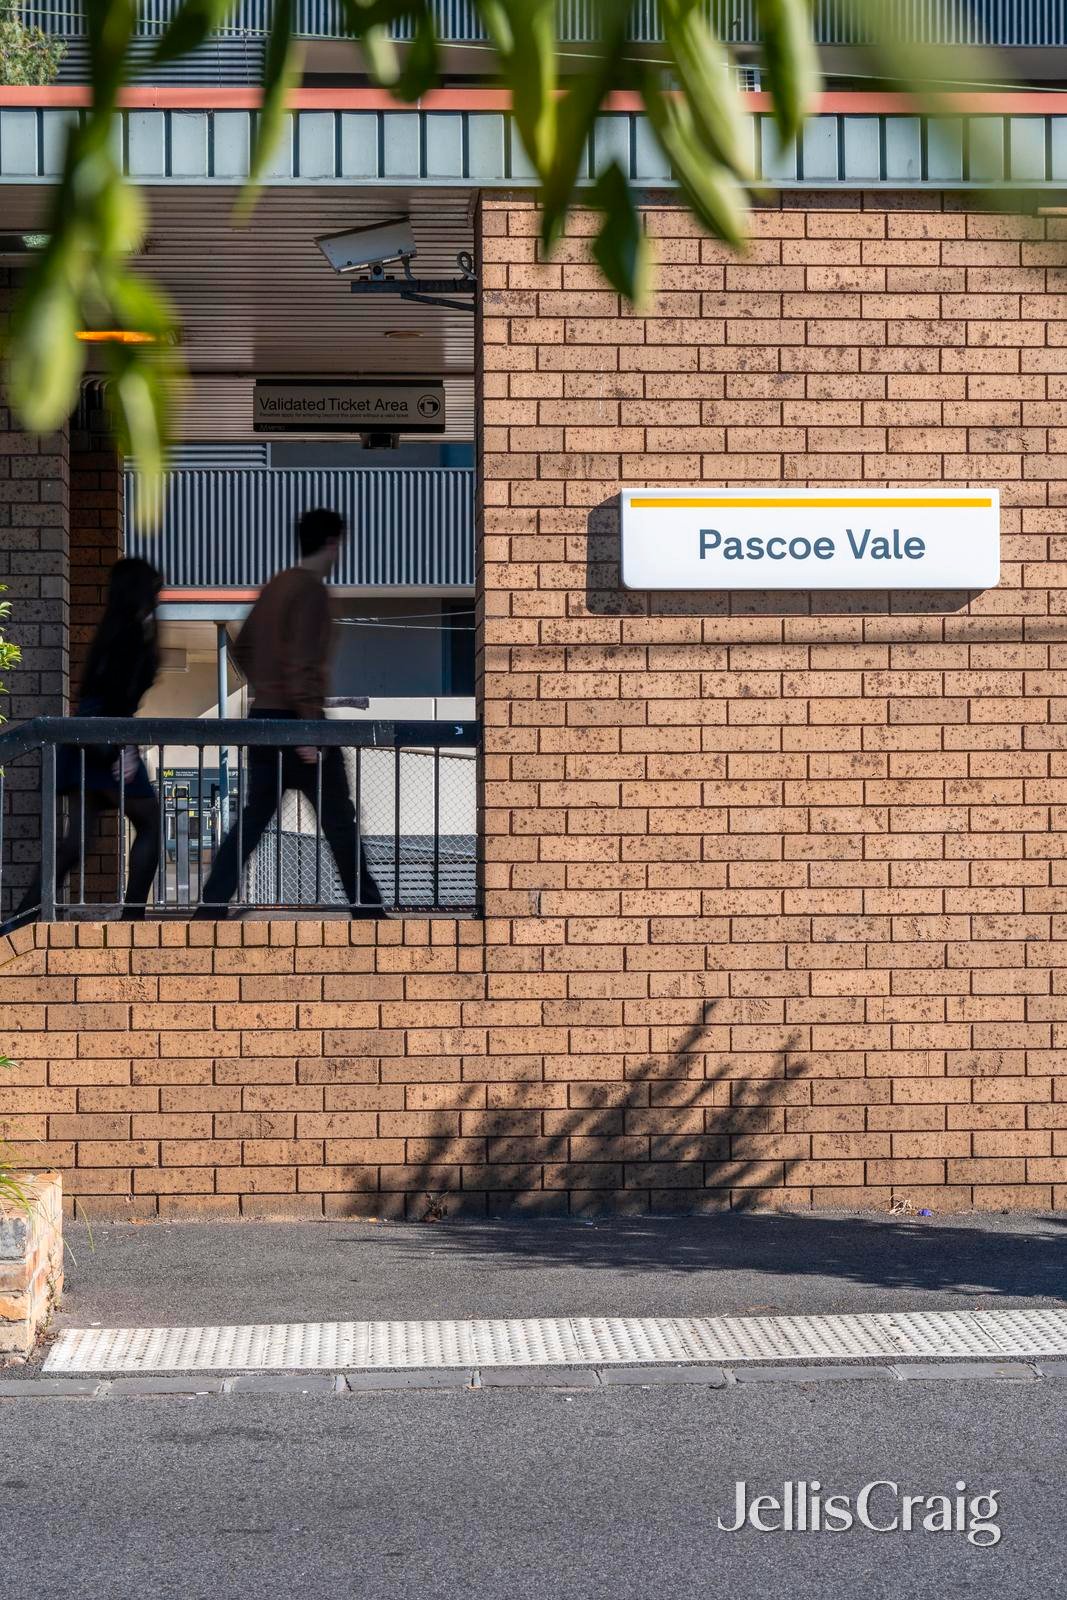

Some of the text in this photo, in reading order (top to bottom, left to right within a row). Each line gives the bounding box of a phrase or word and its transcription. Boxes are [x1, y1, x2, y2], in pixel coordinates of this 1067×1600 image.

[259, 397, 408, 411] Validated Ticket Area
[699, 528, 926, 560] Pascoe Vale
